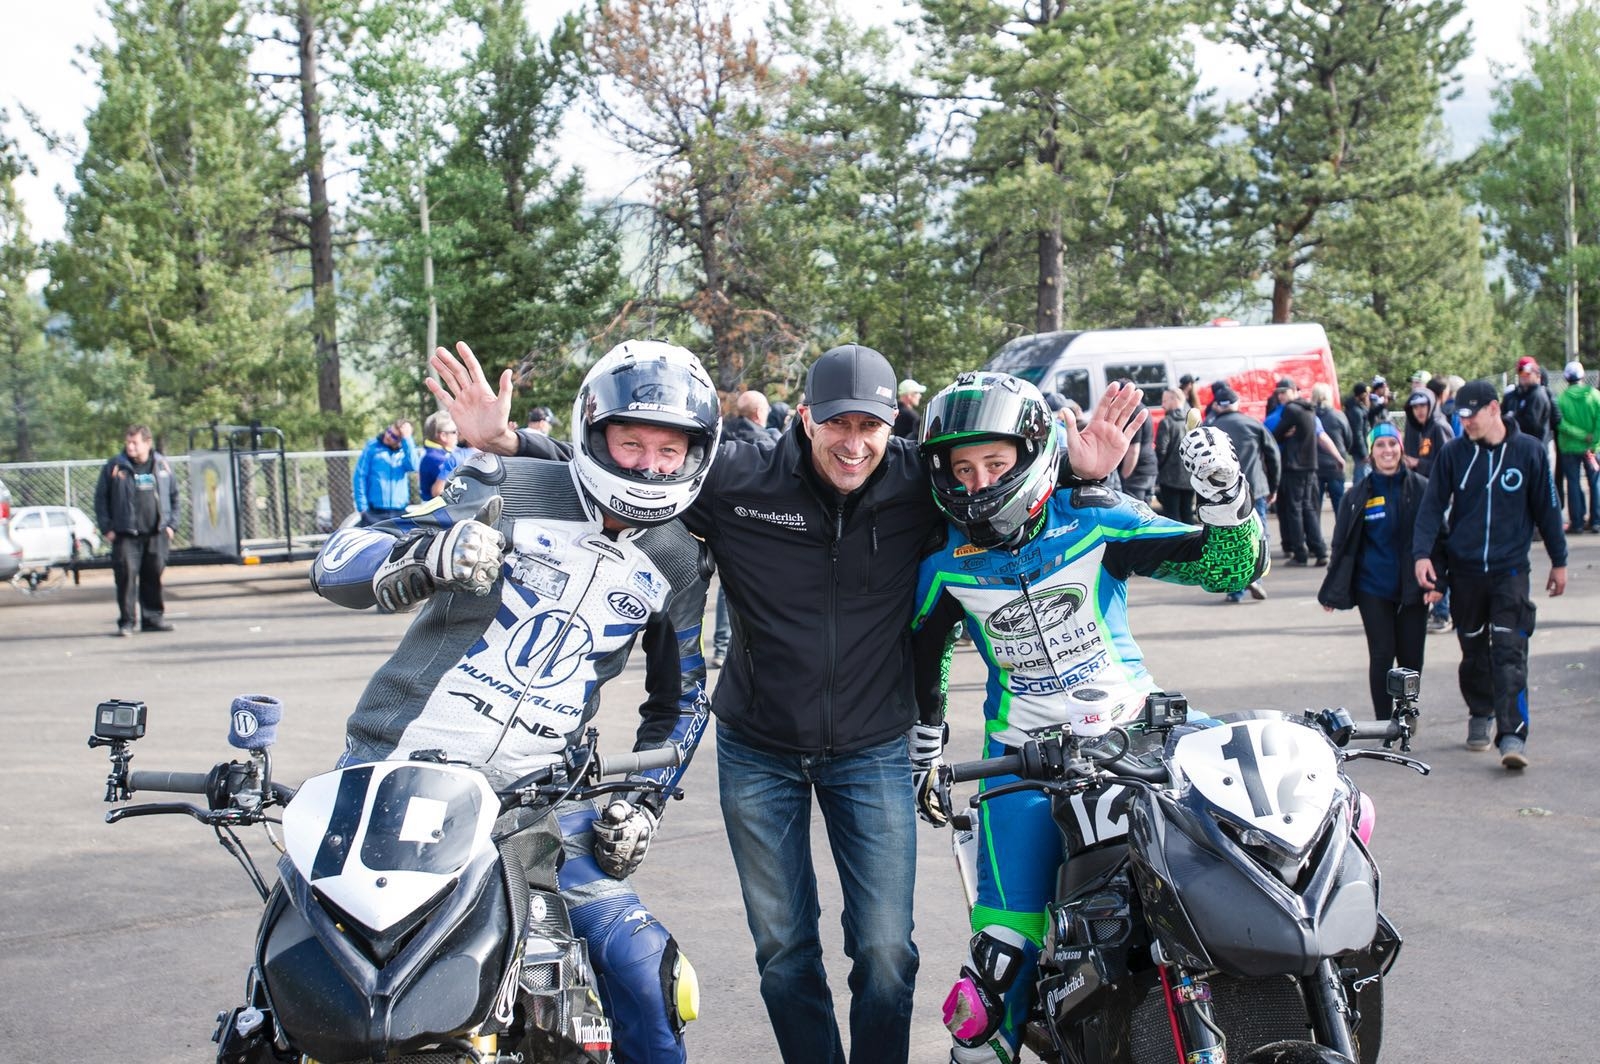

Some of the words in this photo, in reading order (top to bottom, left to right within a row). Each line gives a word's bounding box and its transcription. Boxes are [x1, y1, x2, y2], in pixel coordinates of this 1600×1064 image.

[624, 504, 674, 516] Wunderlich
[748, 509, 804, 522] Wunderlich
[610, 596, 645, 617] Arai
[994, 621, 1097, 657] PROKASRO
[1010, 652, 1107, 692] SCHUBERT
[457, 663, 583, 717] WUNDERLICH
[1053, 973, 1085, 1003] Wunderlich
[572, 1016, 612, 1044] Wunderlich
